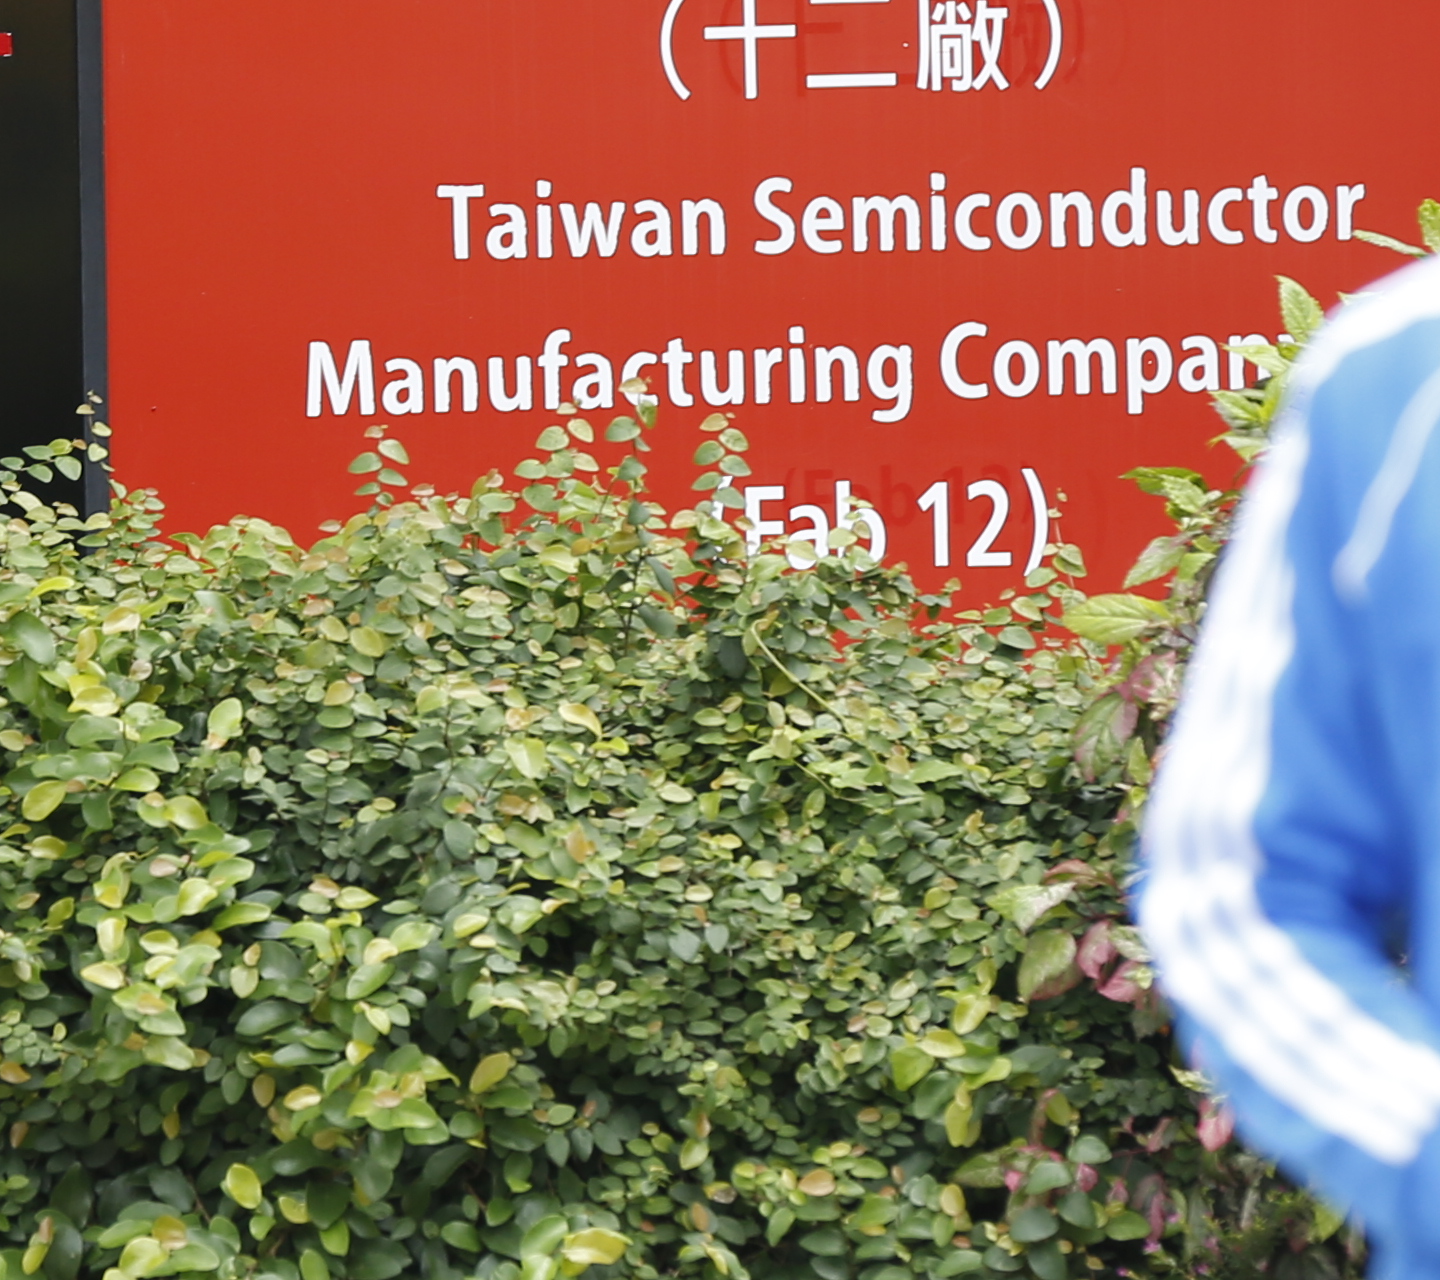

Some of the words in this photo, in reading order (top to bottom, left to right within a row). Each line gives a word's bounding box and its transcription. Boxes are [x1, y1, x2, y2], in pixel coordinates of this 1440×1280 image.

[435, 180, 728, 262] Taiwan
[753, 168, 1367, 255] Semiconductor
[306, 324, 914, 422] Manufacturing
[940, 322, 1296, 415] Compan
[917, 468, 1050, 577] 12)
